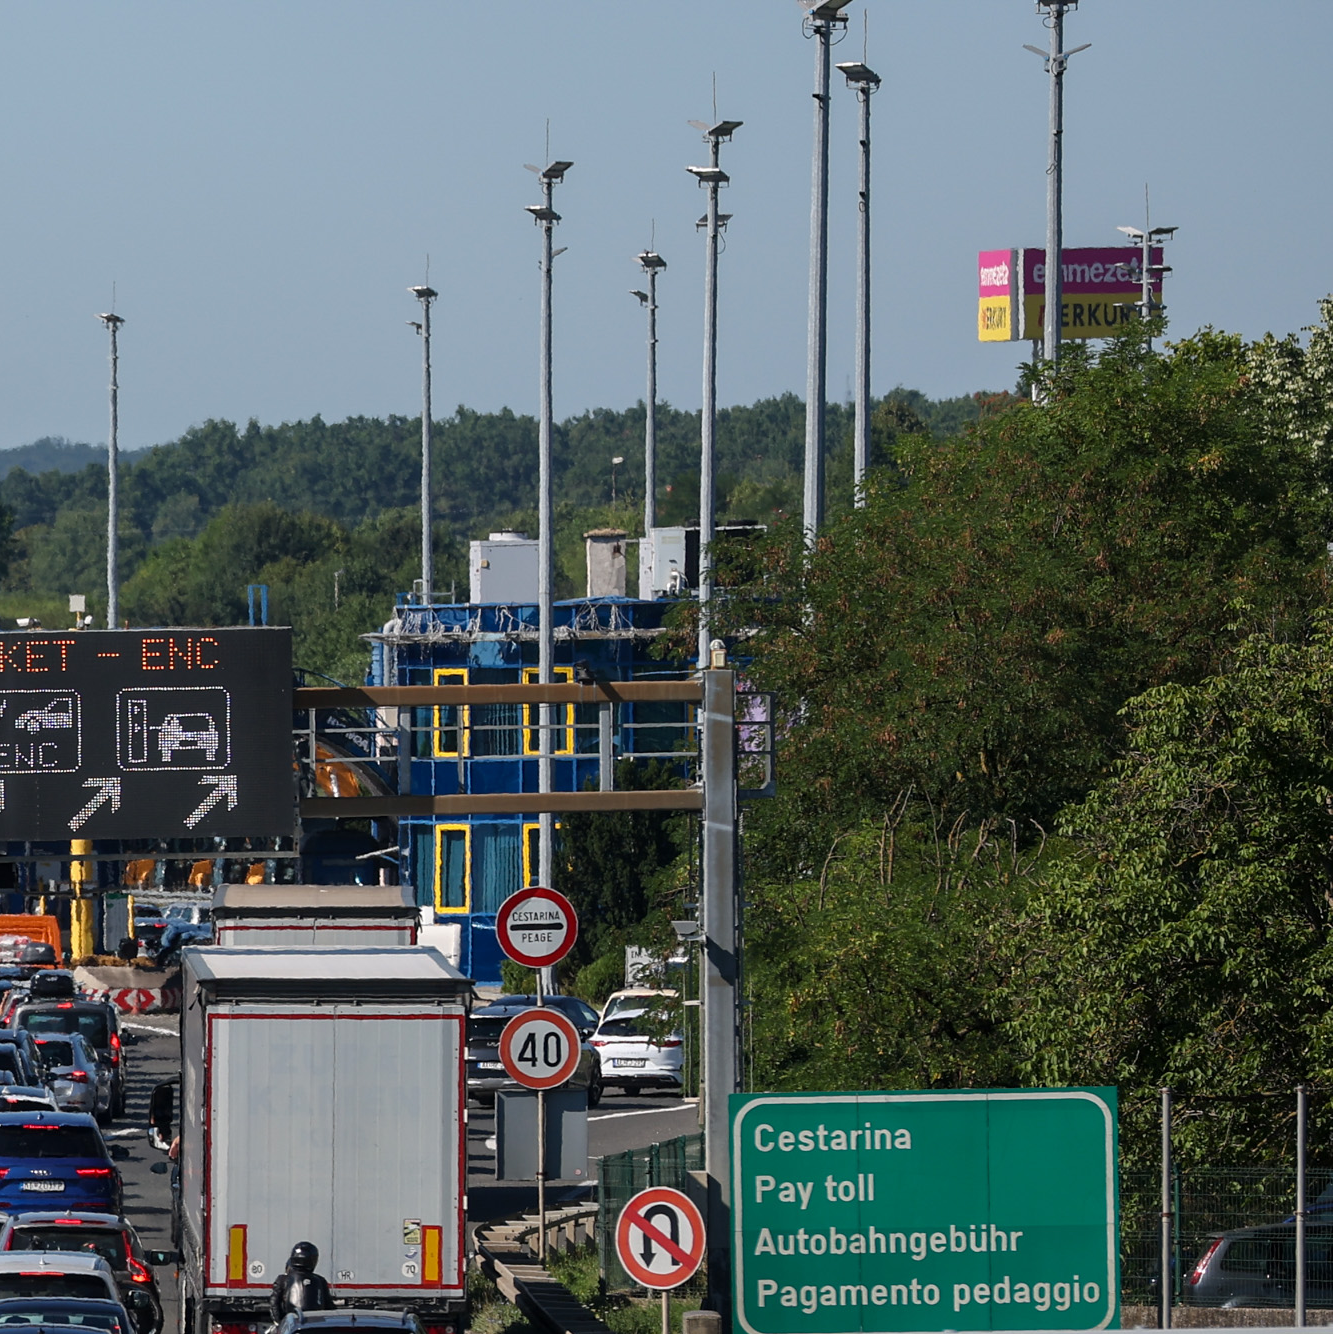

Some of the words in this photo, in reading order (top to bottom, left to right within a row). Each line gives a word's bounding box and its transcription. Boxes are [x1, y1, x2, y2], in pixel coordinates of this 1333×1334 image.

[142, 637, 219, 670] ENC
[512, 911, 561, 922] CESTARINA
[522, 932, 552, 943] PEAGE
[517, 1032, 562, 1067] 40
[754, 1123, 912, 1152] Cestarina
[755, 1177, 810, 1209] Pay
[826, 1173, 875, 1202] toll
[754, 1224, 1023, 1260] Autobahngebühr
[758, 1278, 940, 1314] Pagamento
[953, 1274, 1100, 1311] pedaggio
